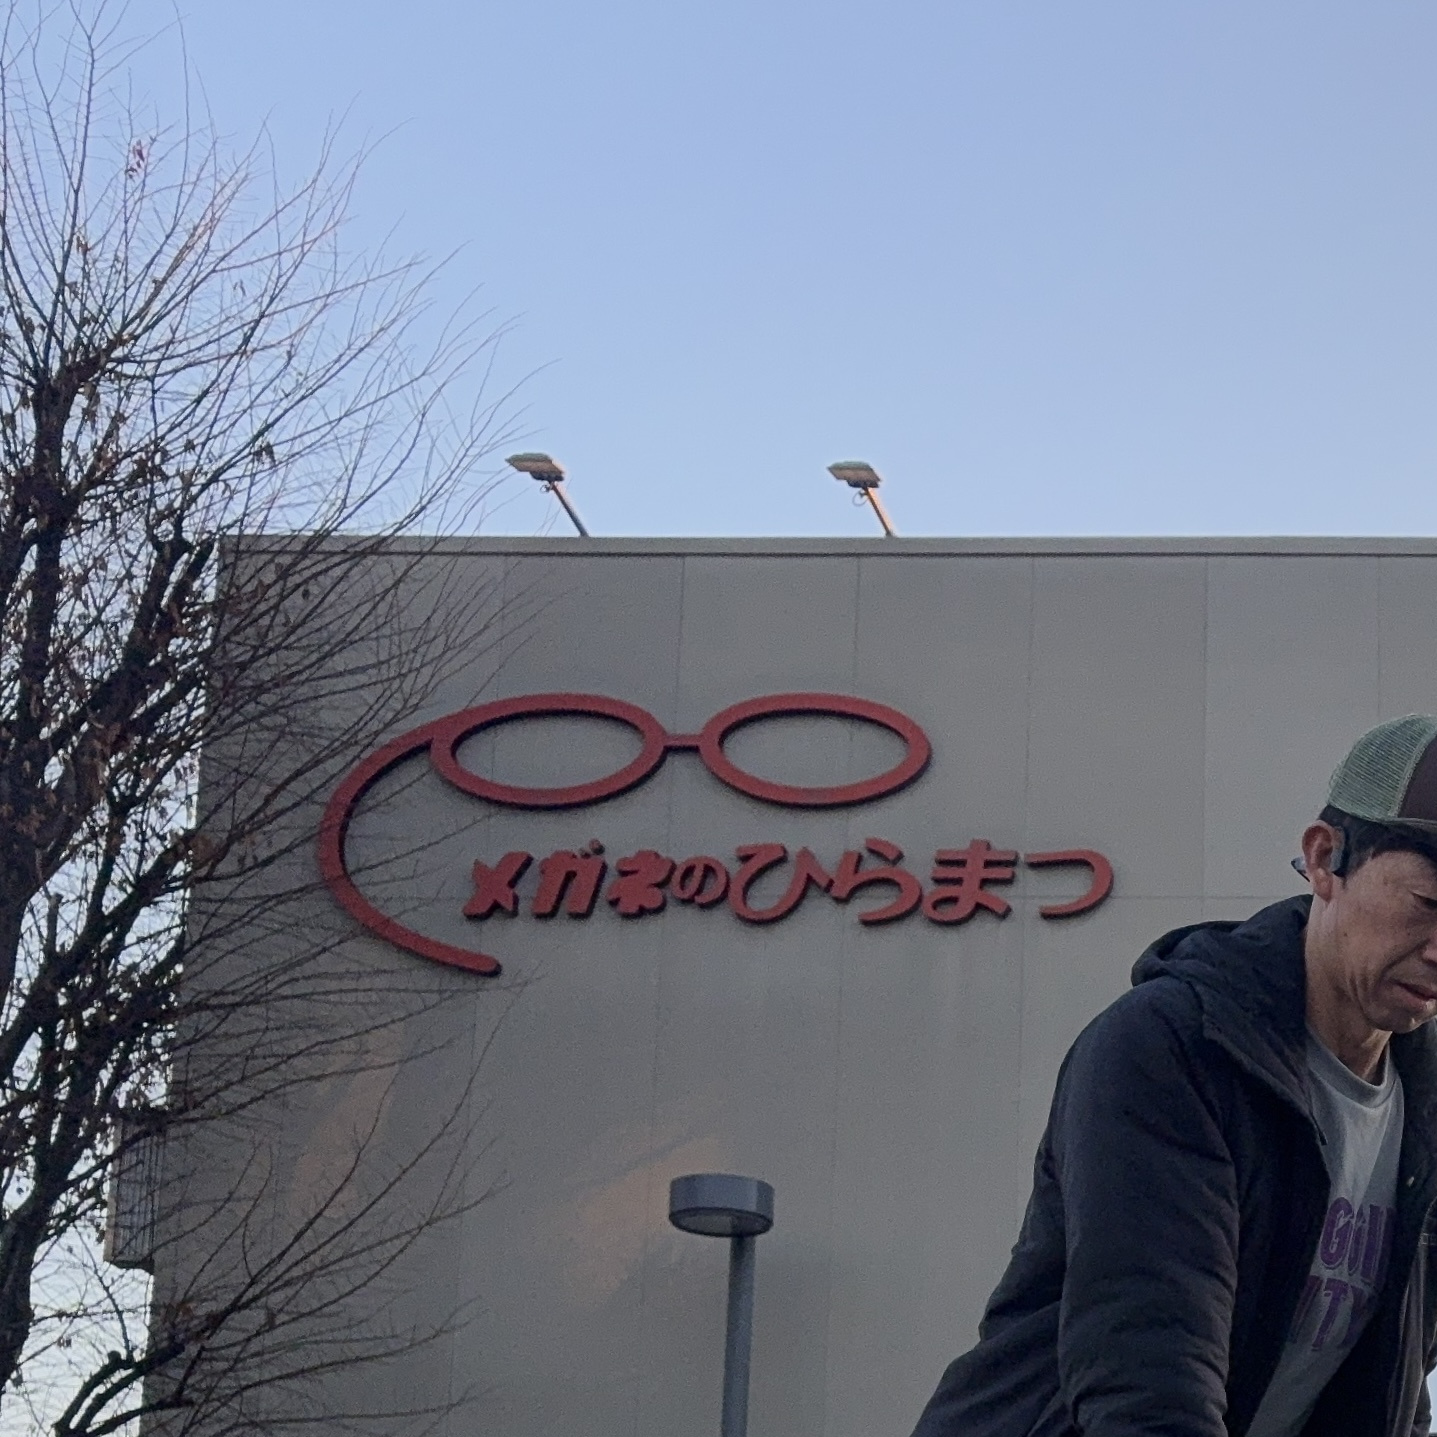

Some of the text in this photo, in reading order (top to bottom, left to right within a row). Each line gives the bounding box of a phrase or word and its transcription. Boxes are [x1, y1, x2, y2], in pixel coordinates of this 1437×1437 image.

[461, 836, 1114, 924] メガネのひらまつ
